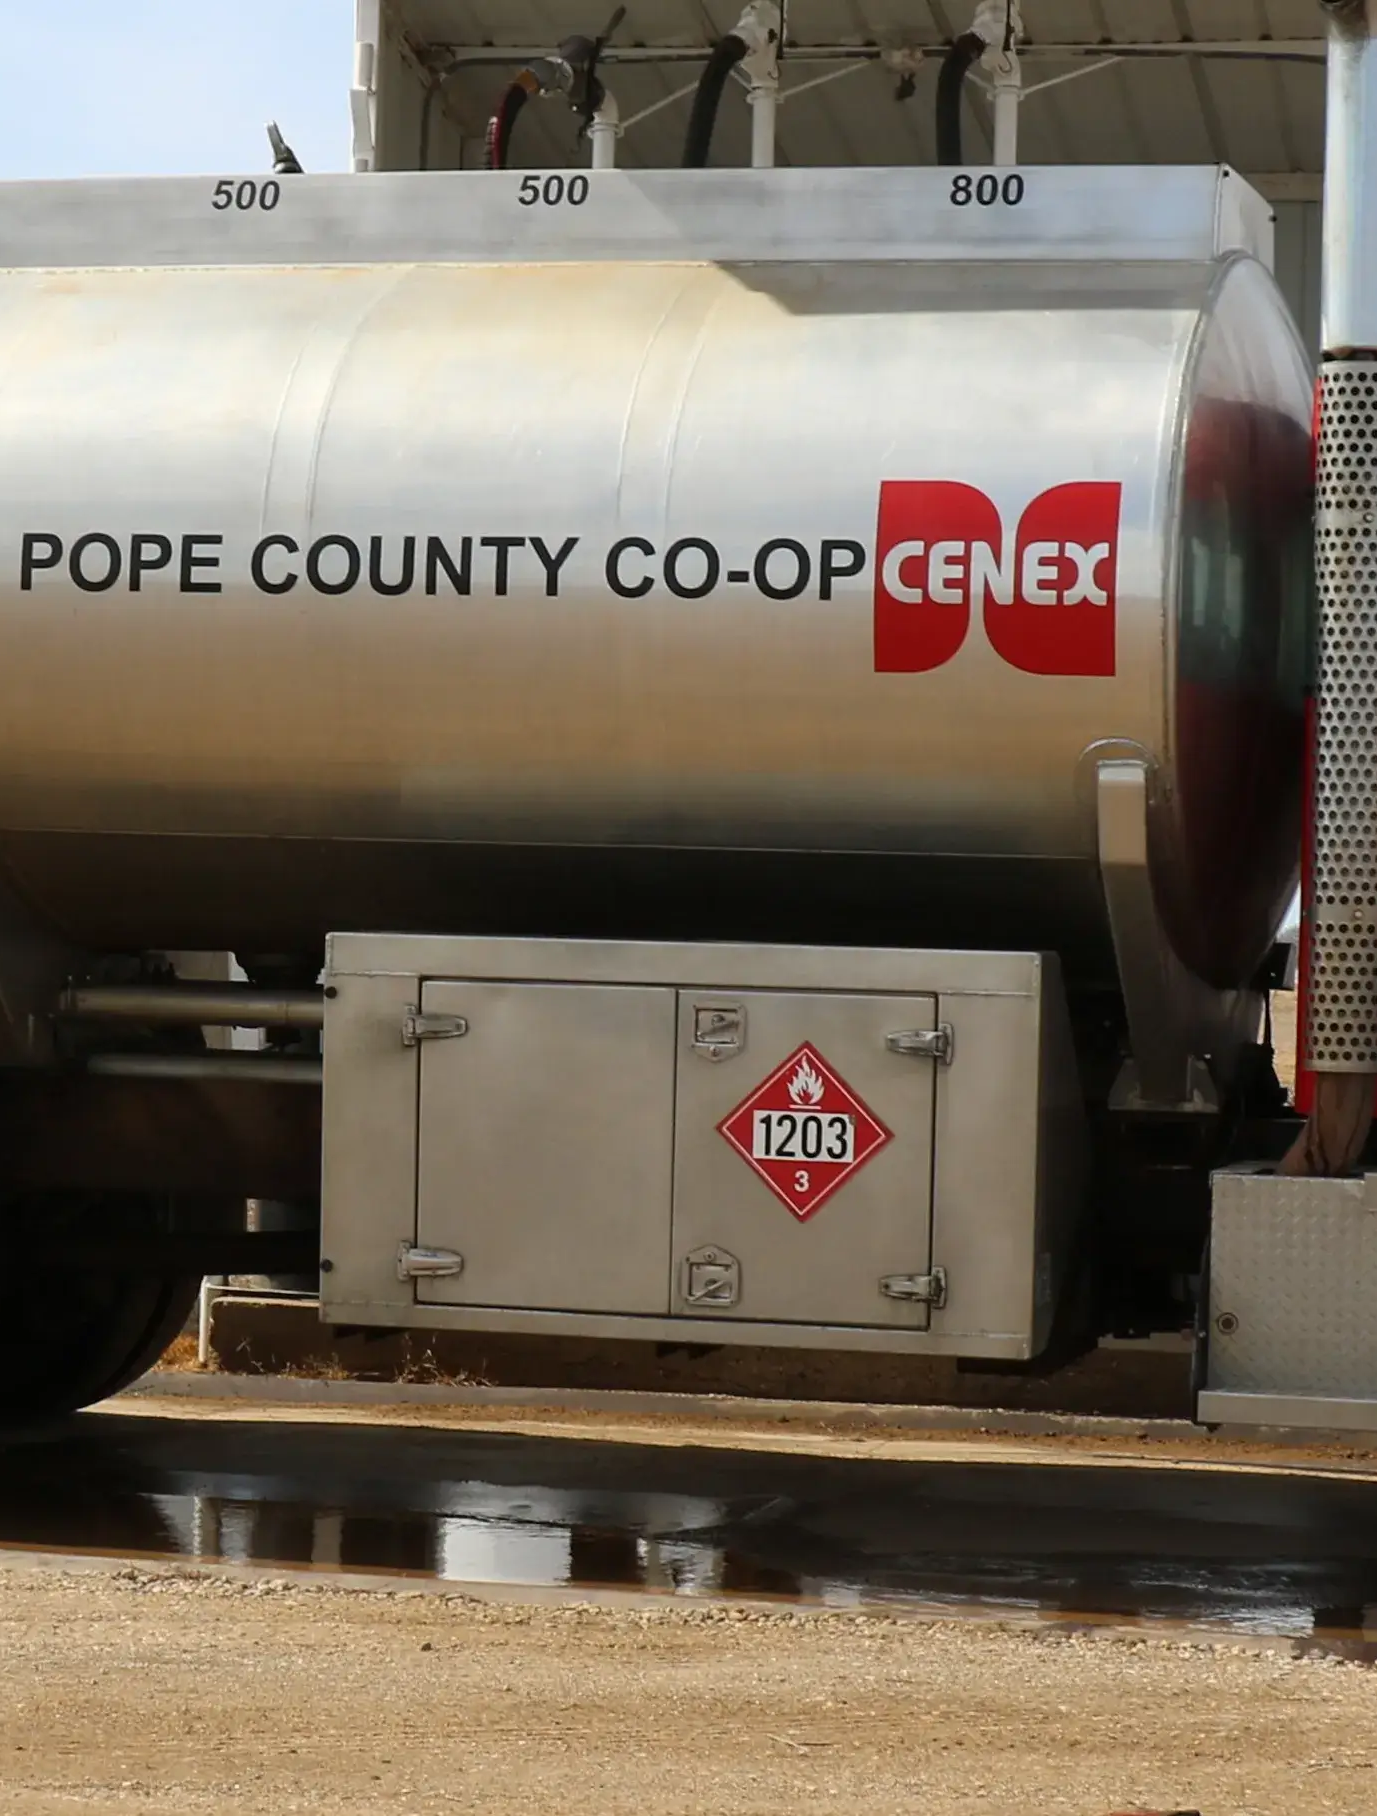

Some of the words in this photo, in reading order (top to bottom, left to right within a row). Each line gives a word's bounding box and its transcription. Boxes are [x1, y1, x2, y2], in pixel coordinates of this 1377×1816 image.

[212, 180, 280, 211] 500
[518, 174, 589, 206] 500
[949, 173, 1024, 206] 800
[20, 532, 223, 594] POPE
[250, 534, 580, 597] COUNTY
[605, 536, 866, 601] CO-OP
[881, 539, 1111, 607] CENEX
[759, 1113, 848, 1160] 1203
[793, 1169, 810, 1193] 3
